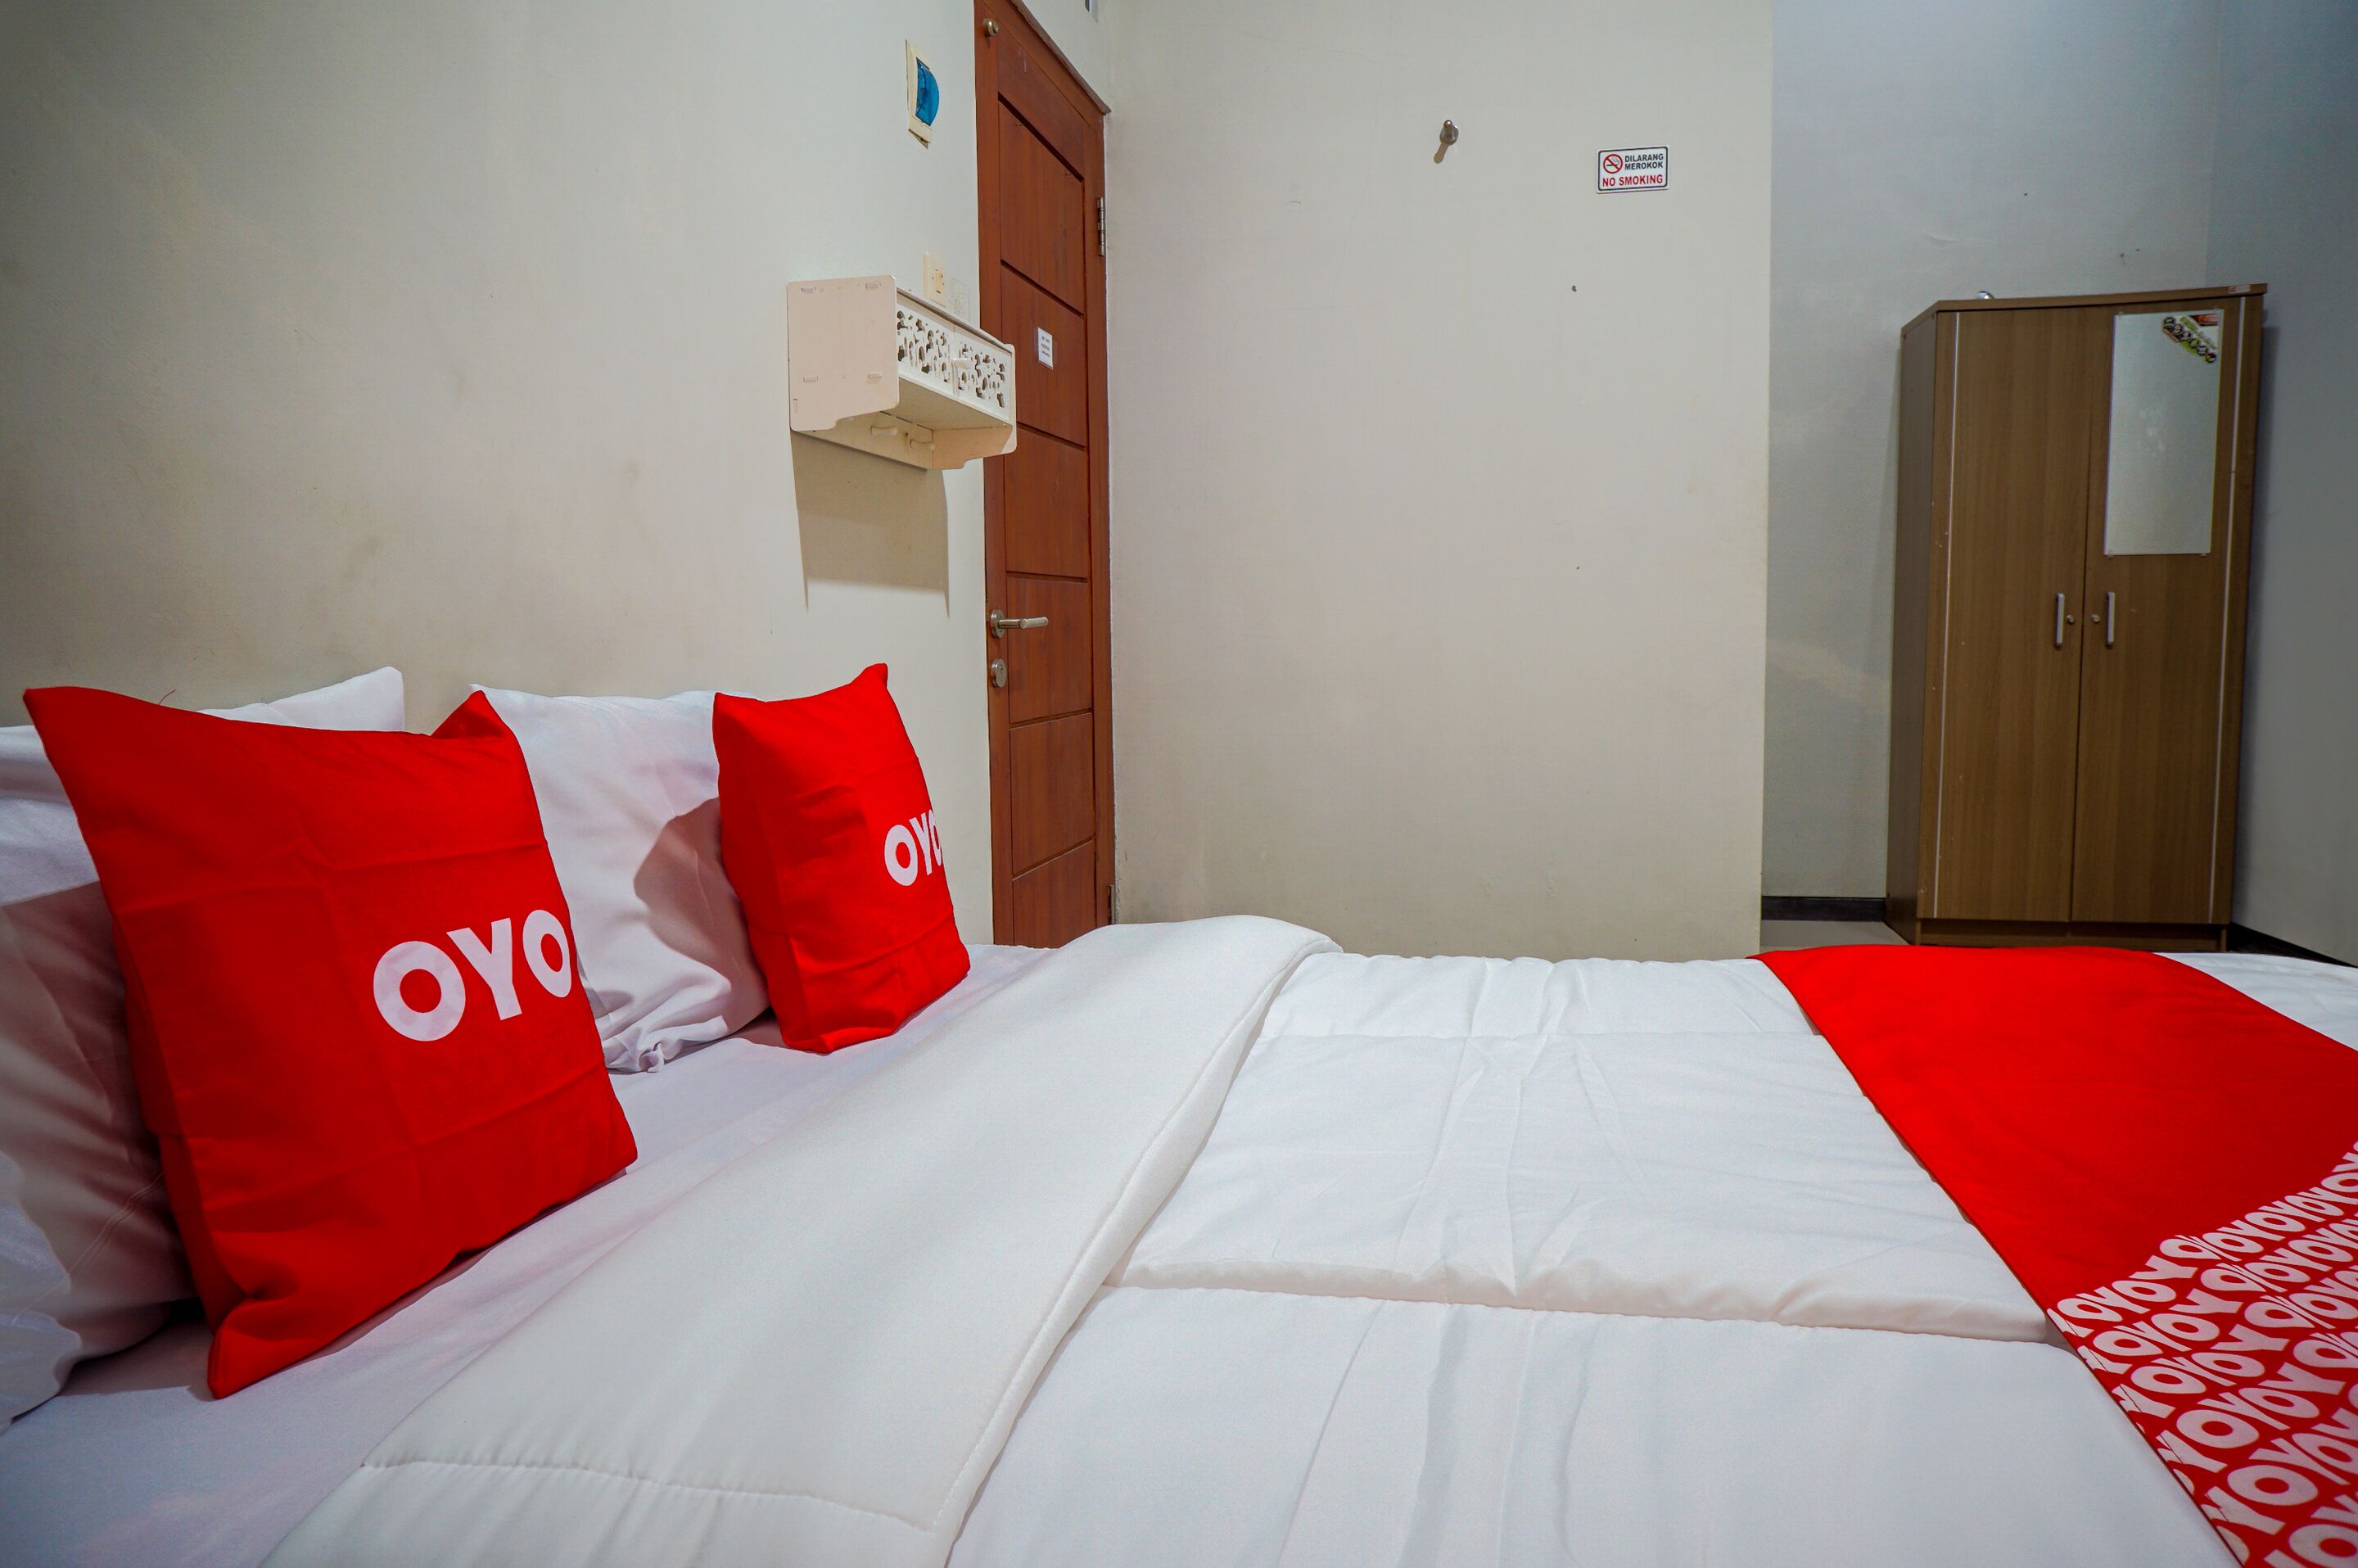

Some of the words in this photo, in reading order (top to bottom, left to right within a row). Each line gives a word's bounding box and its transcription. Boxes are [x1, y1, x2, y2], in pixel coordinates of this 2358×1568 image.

[1624, 153, 1664, 163] DILARANG
[1624, 161, 1664, 170] MEROKOK
[1602, 177, 1616, 188] NO
[1619, 174, 1664, 186] SMOKING
[884, 809, 942, 886] OYO
[373, 909, 571, 1042] OYO
